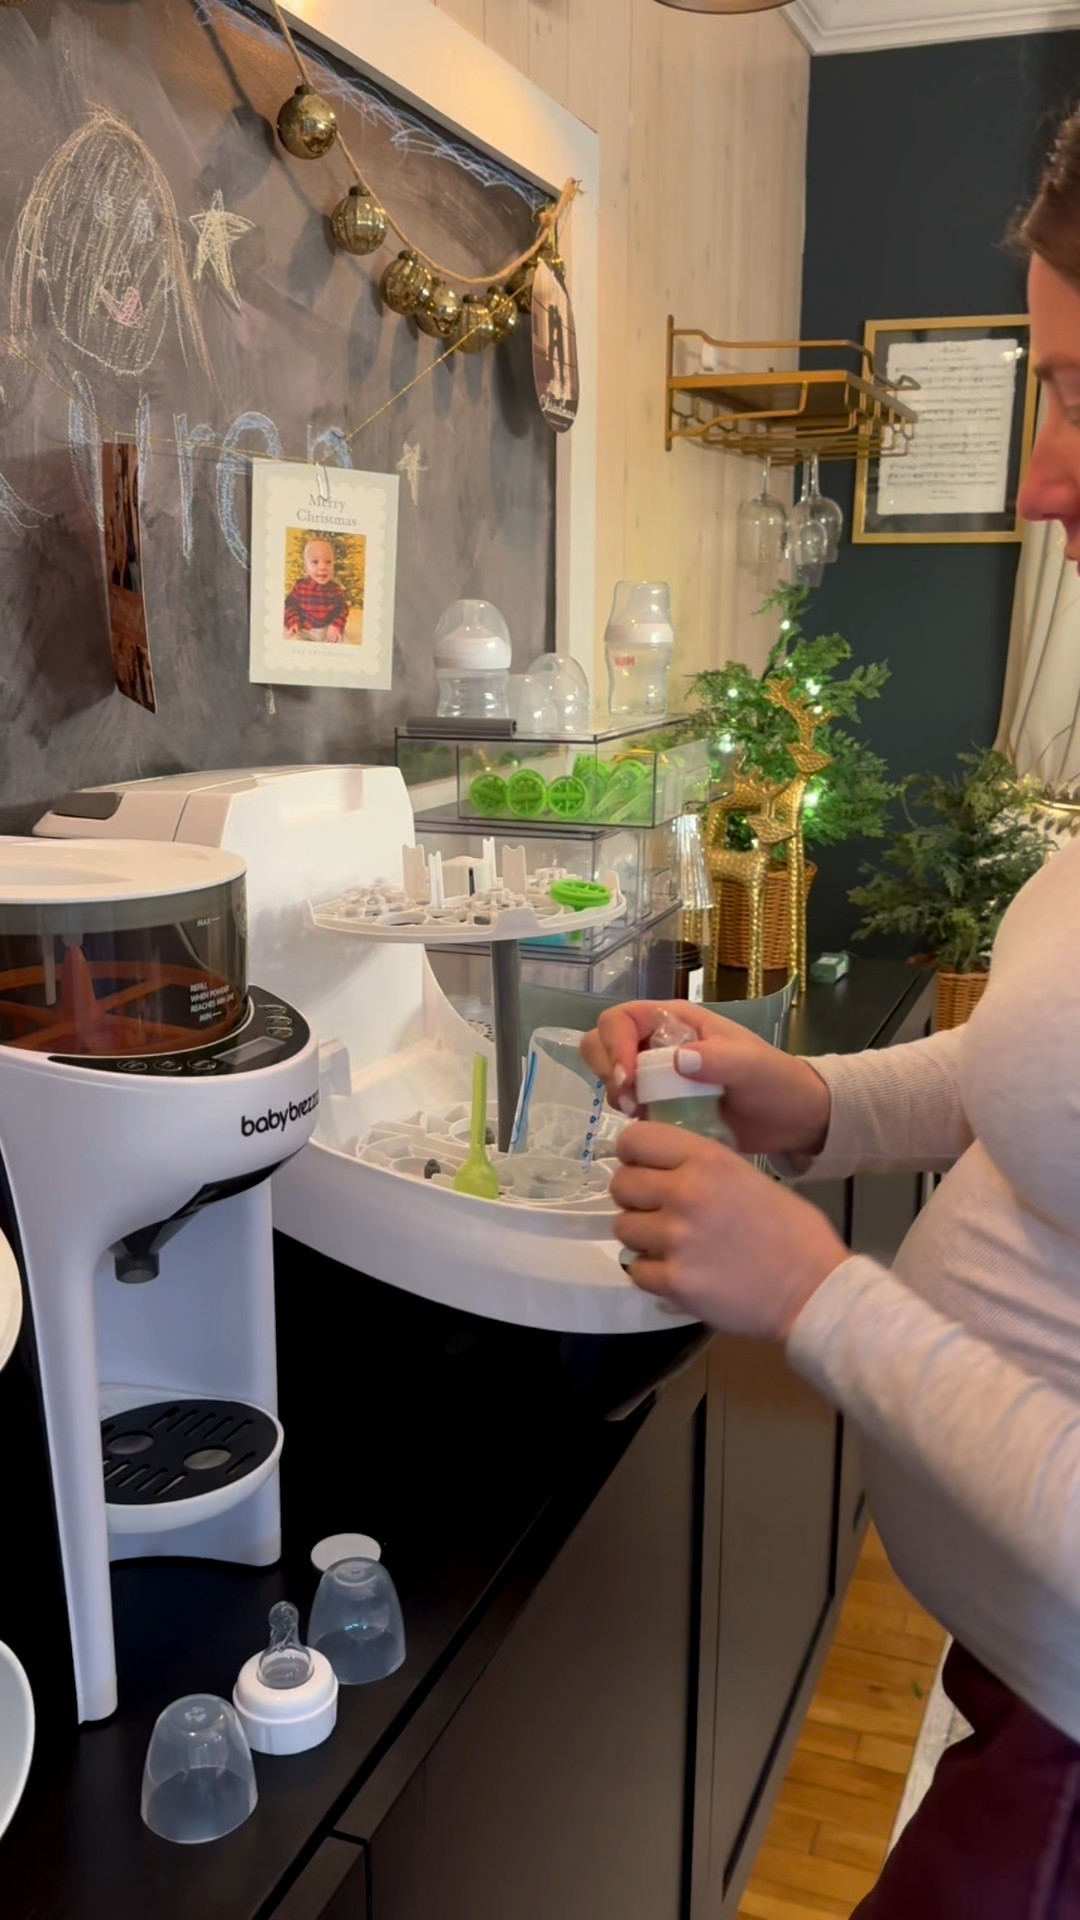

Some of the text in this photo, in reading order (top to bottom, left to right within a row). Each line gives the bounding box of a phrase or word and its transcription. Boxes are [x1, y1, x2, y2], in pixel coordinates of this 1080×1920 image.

[308, 494, 346, 512] Merry
[296, 508, 357, 526] Christmas
[197, 917, 211, 927] MAX
[190, 982, 208, 993] REFILL
[190, 984, 230, 1003] WHEN POWDER
[190, 1000, 216, 1013] REACHES
[199, 1011, 213, 1022] MIN
